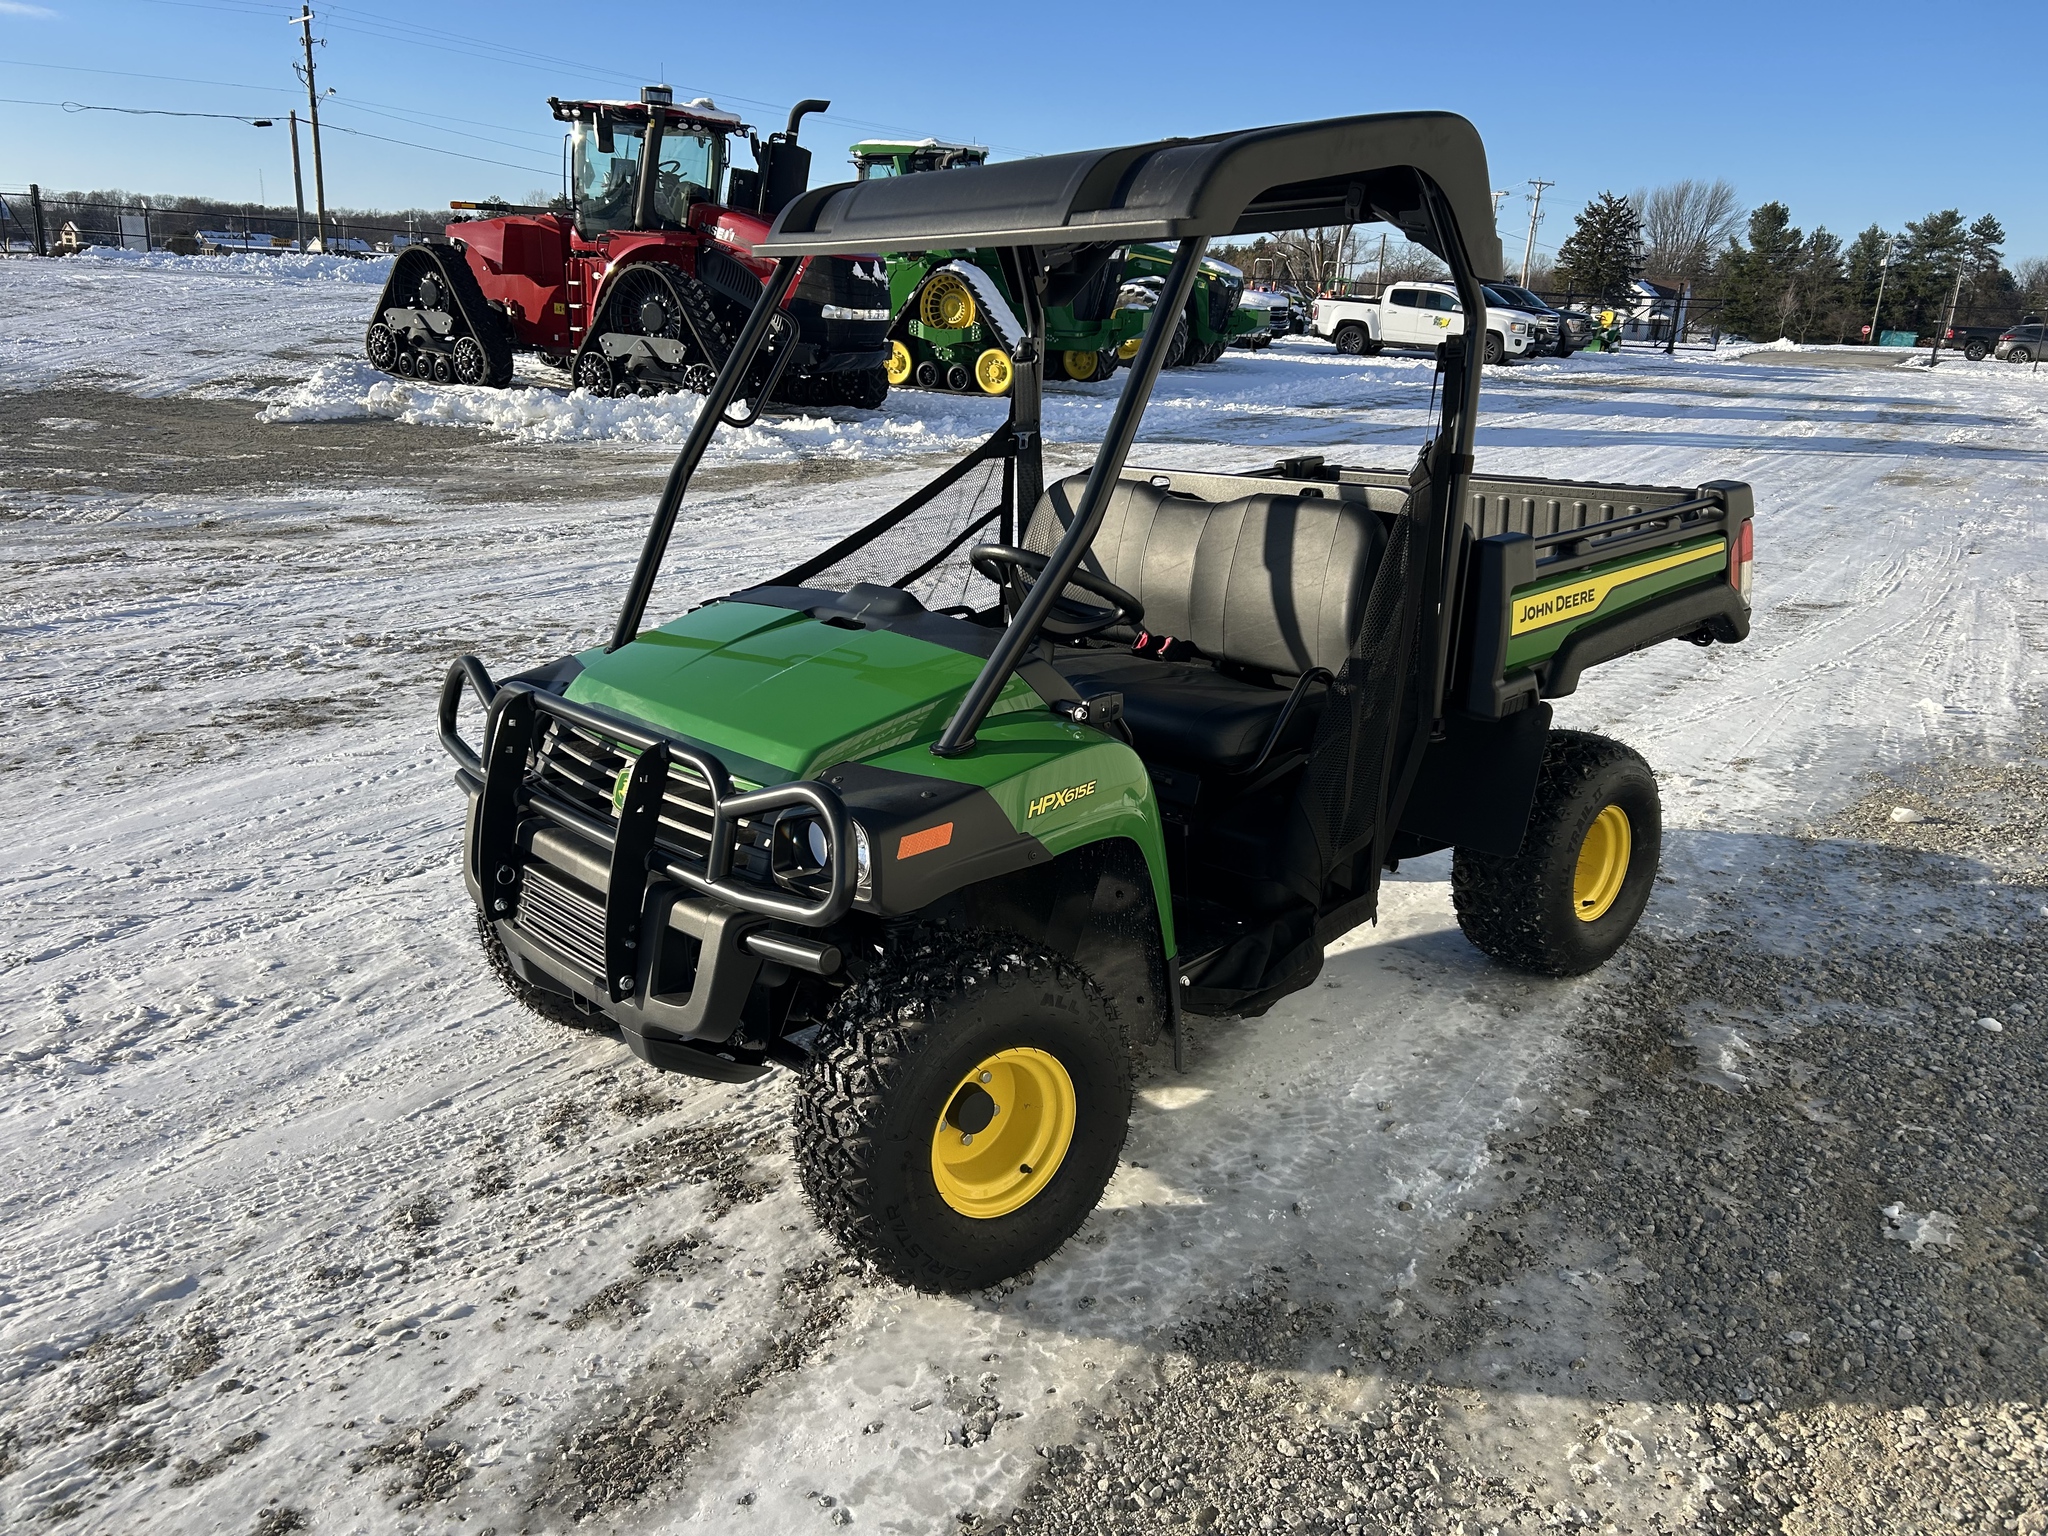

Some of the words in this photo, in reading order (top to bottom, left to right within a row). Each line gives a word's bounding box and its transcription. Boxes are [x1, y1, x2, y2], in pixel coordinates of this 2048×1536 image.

[699, 222, 725, 239] CASE
[1520, 601, 1553, 623] JOHN
[1556, 588, 1595, 612] DEERE
[1027, 779, 1097, 819] HPX615E
[1565, 805, 1594, 855] TRAIL
[1040, 993, 1079, 1015] ALL
[885, 1203, 973, 1281] CARLSTAR
